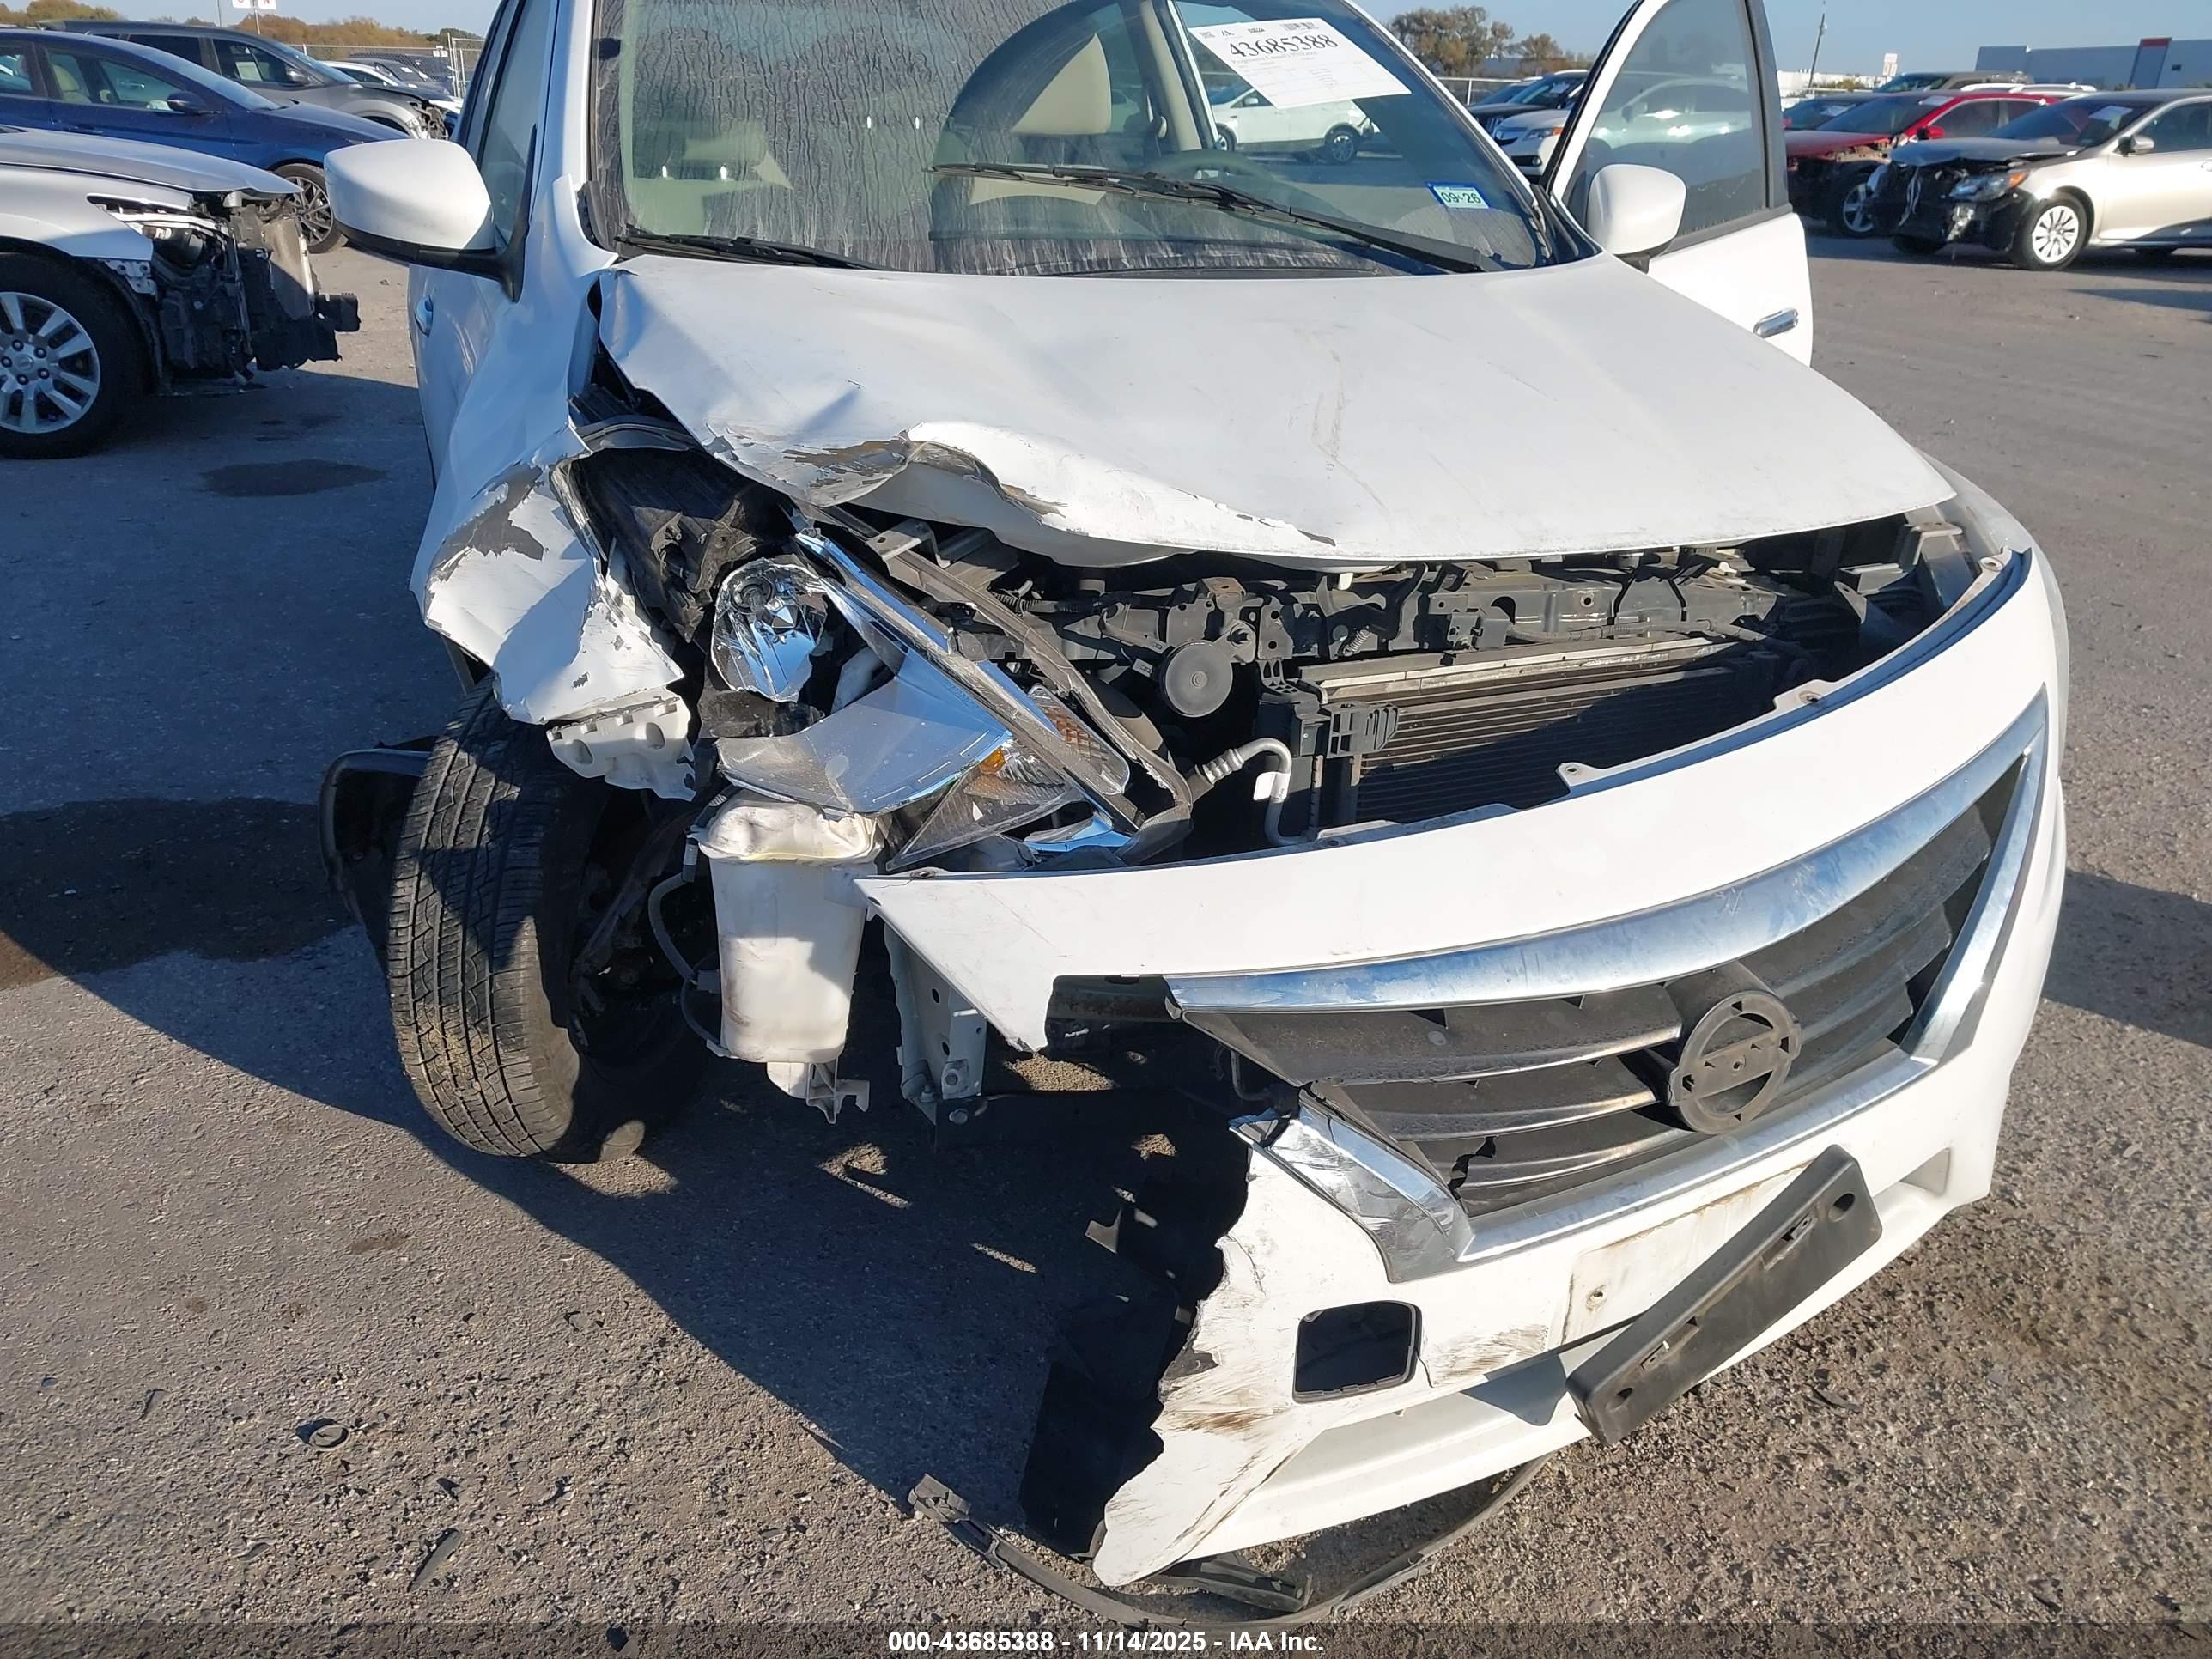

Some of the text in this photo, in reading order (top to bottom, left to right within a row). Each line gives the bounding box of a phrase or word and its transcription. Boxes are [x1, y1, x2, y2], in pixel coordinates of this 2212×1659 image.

[1230, 34, 1338, 57] 43685388
[1441, 192, 1459, 203] 09
[1462, 193, 1481, 204] 26
